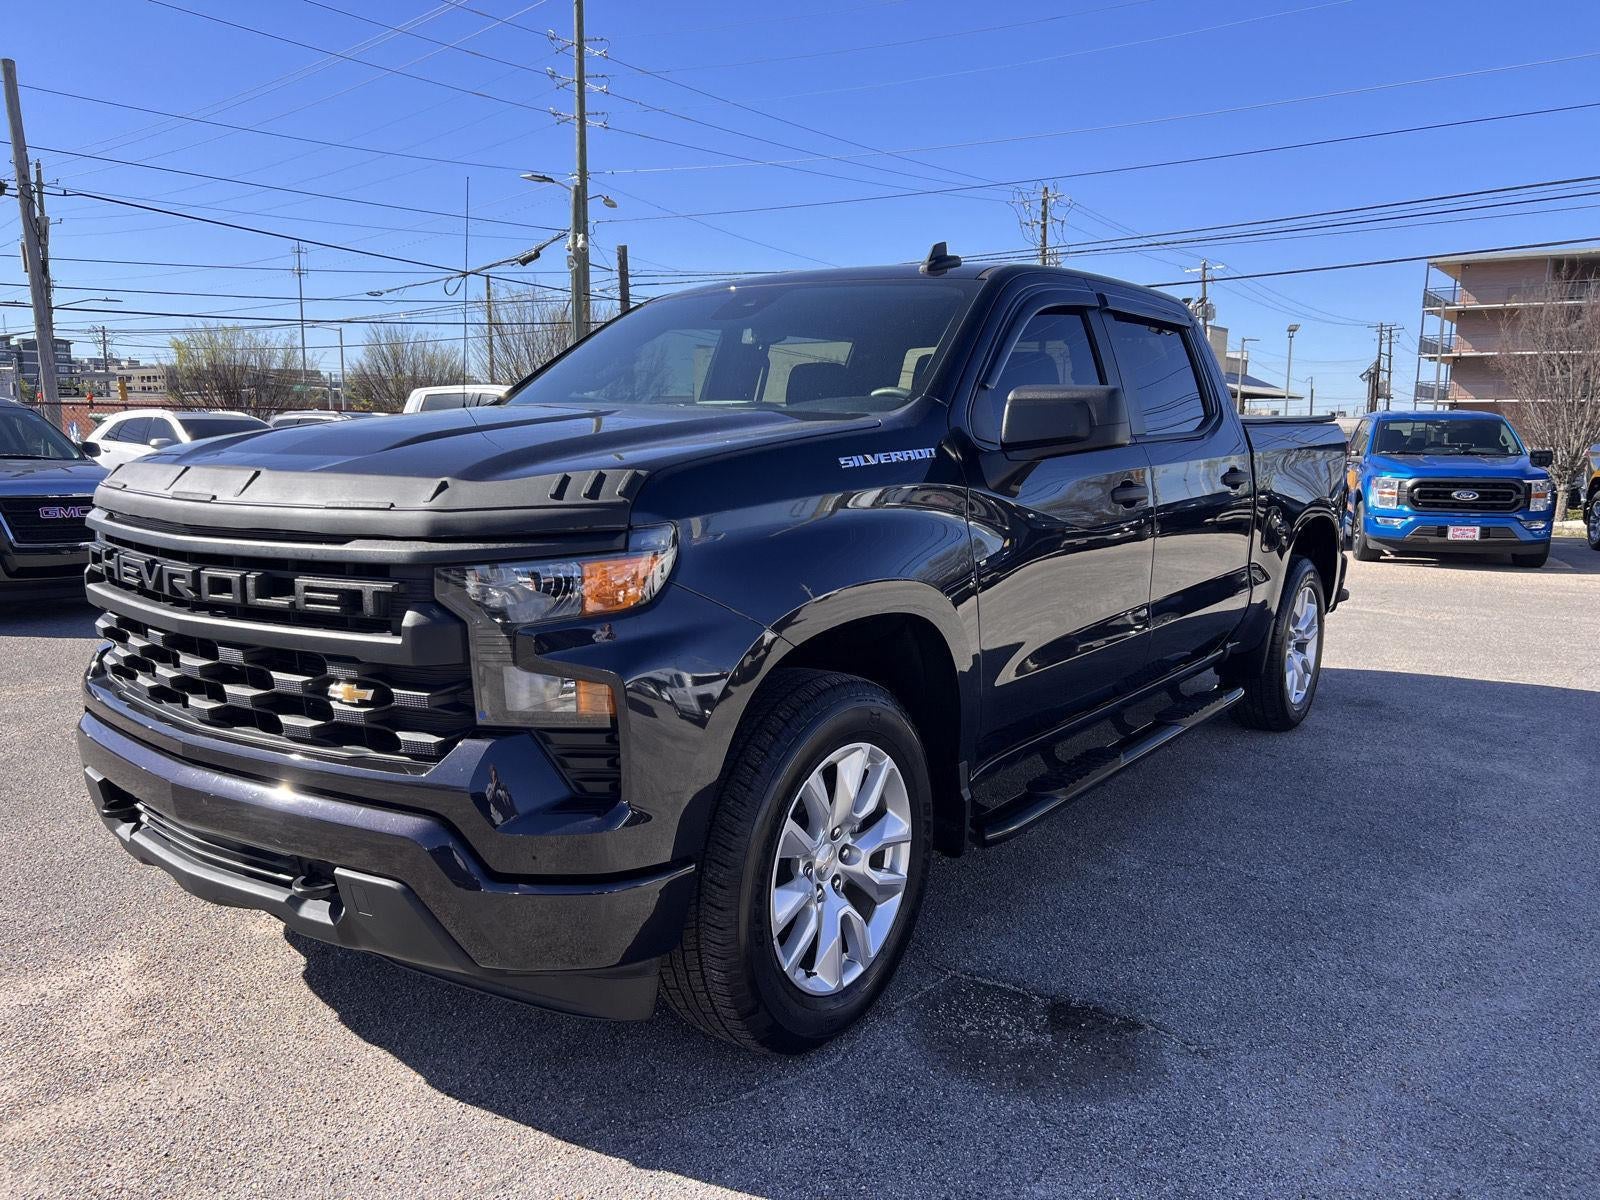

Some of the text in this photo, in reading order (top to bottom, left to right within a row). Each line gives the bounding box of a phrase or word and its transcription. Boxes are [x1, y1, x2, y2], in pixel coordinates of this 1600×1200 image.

[839, 447, 936, 469] SILVERADO
[39, 506, 92, 518] GMC
[89, 543, 397, 616] CHEVROLET
